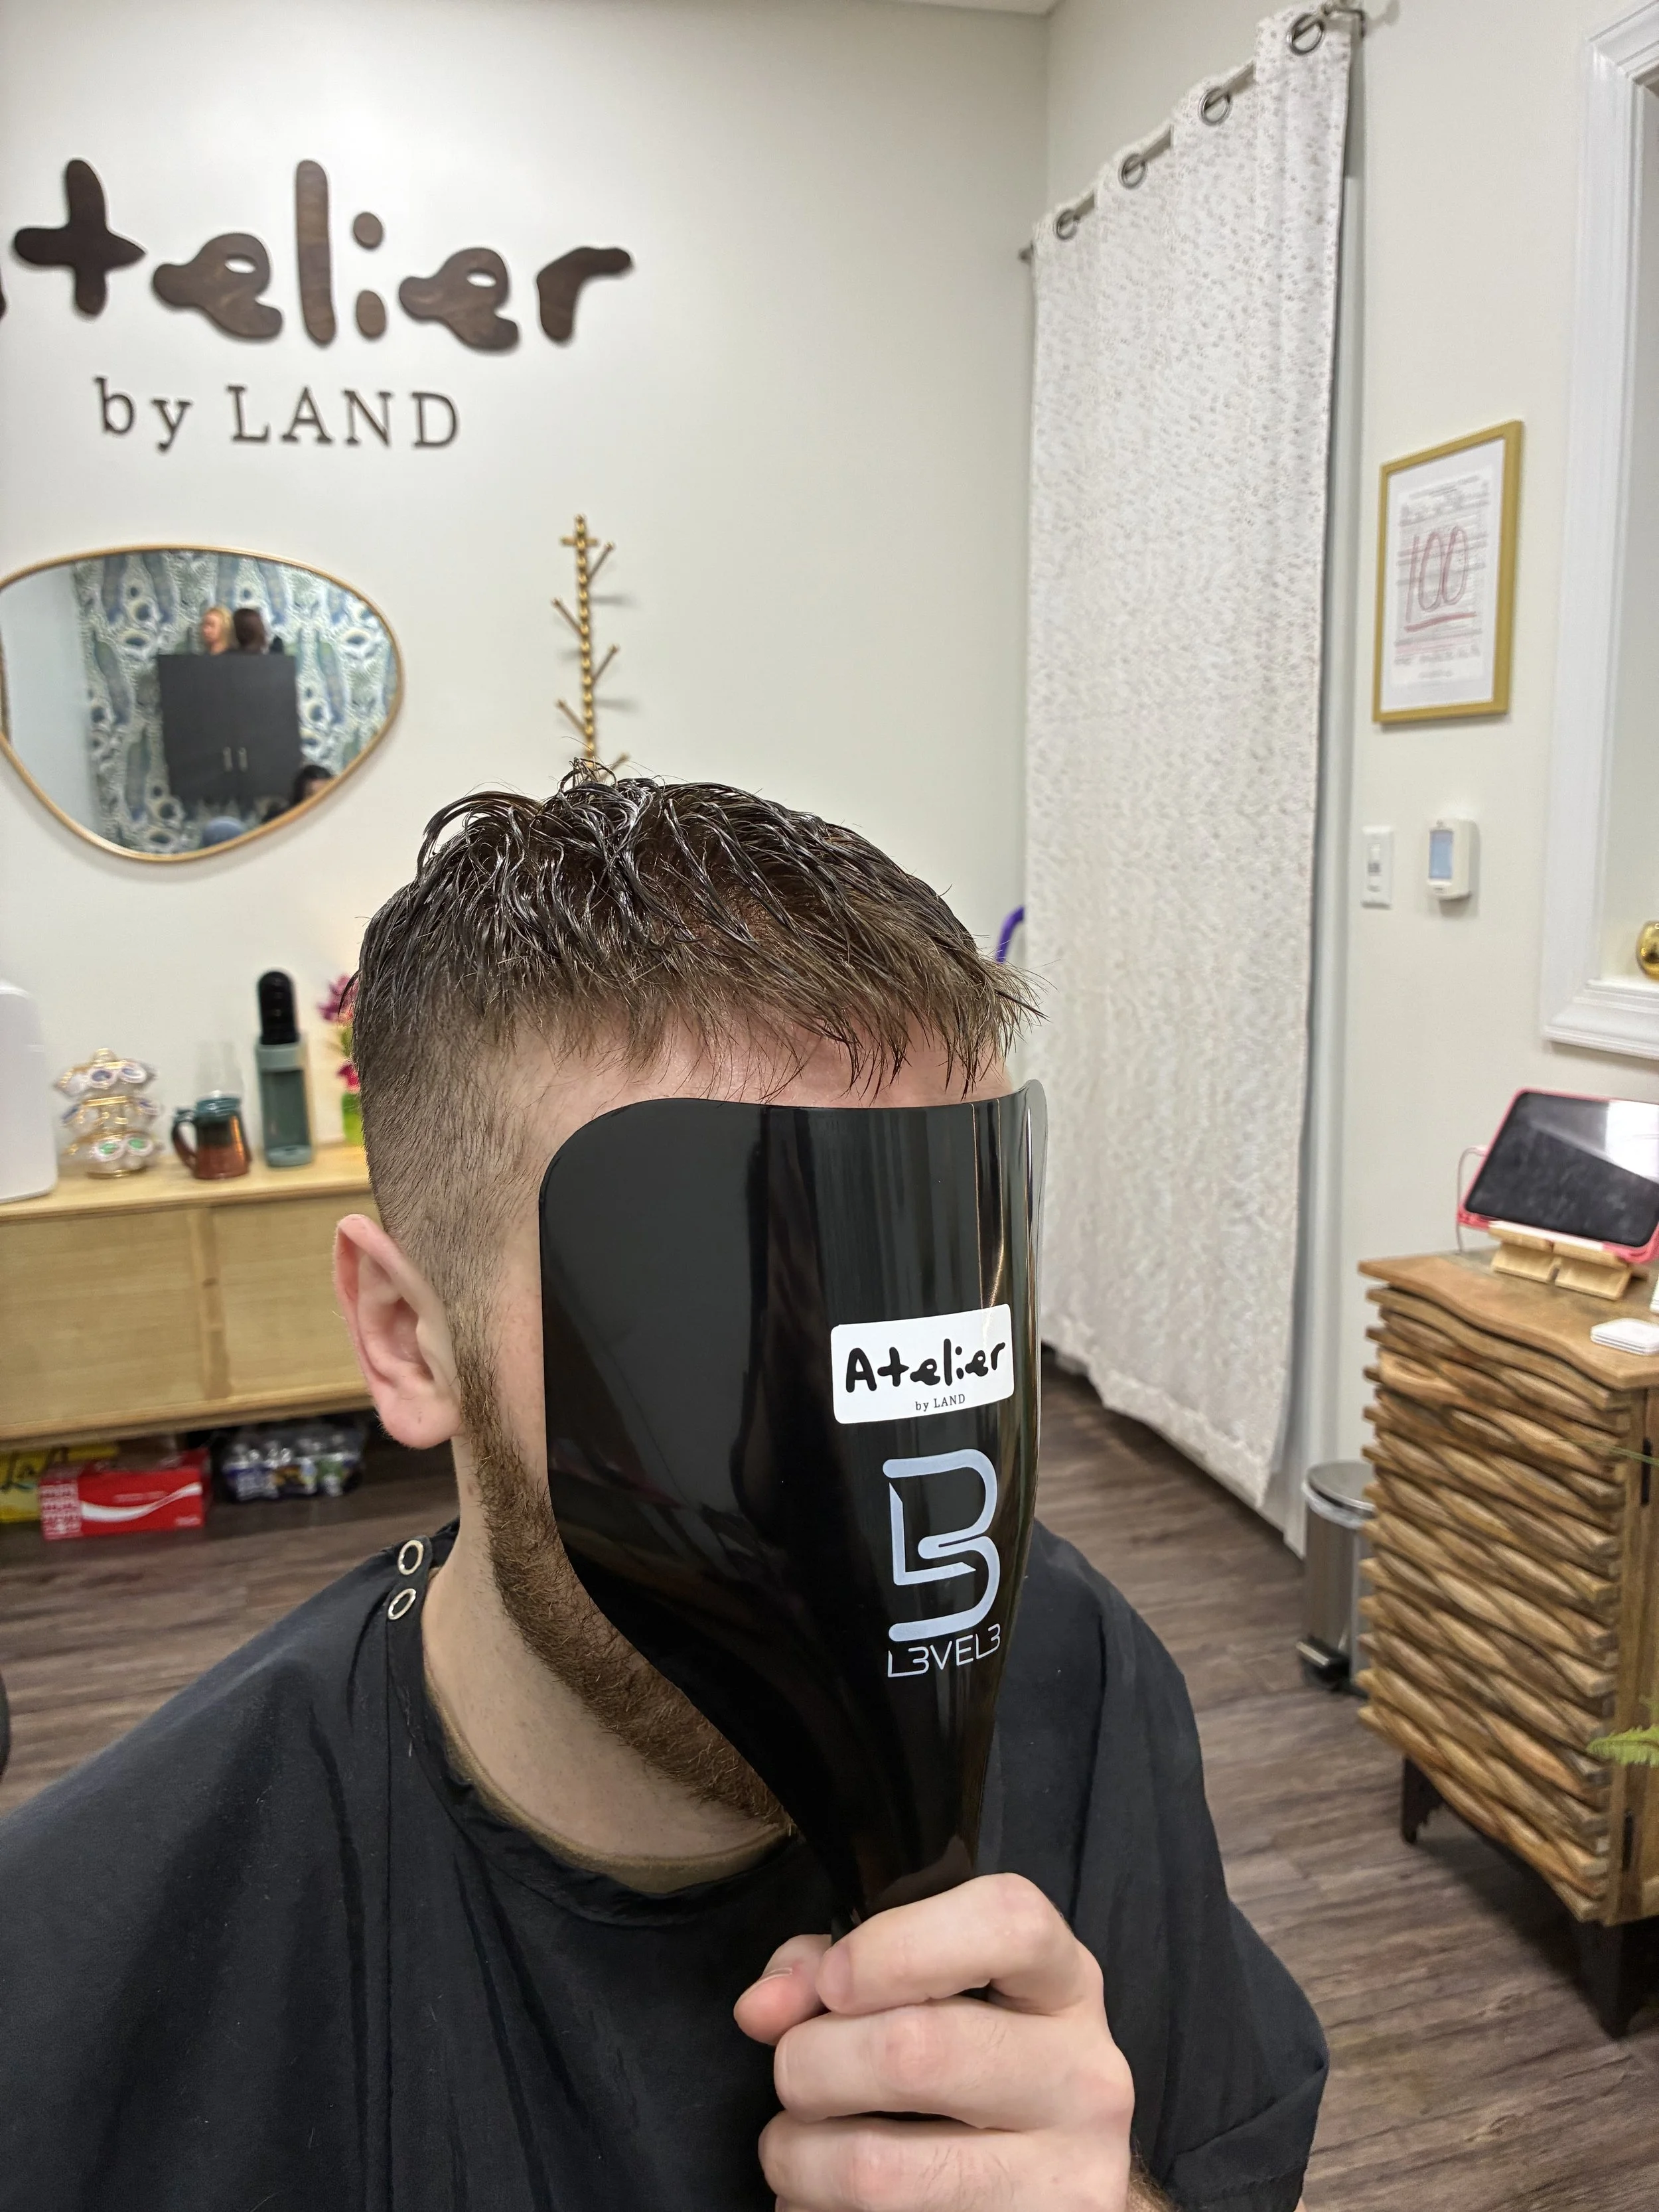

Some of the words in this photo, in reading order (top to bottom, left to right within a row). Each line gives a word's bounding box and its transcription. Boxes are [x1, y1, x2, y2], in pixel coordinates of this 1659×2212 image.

[0, 159, 633, 352] telier
[94, 377, 192, 452] by
[227, 386, 458, 447] LAND
[1406, 525, 1469, 623] 100
[845, 1338, 1006, 1392] Atelier
[915, 1401, 929, 1412] by
[933, 1394, 966, 1408] LAND
[887, 1623, 1001, 1678] L3VEL3
